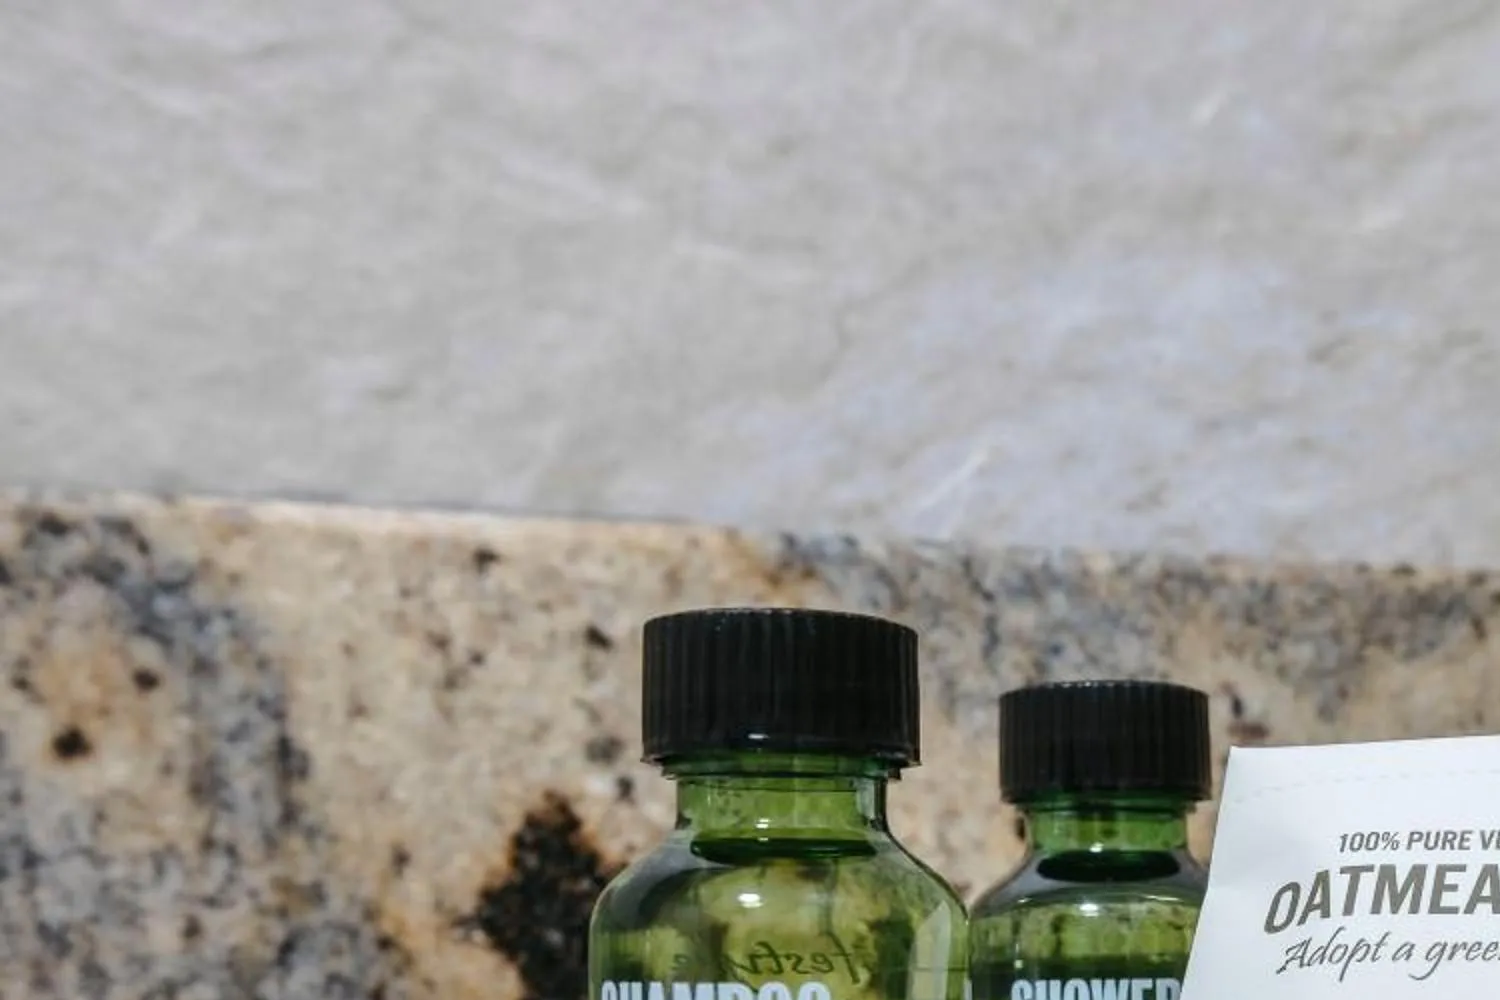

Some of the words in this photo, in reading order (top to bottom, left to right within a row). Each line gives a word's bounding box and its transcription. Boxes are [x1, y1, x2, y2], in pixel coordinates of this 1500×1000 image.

[1338, 830, 1400, 853] 100%
[1406, 829, 1472, 851] PURE
[1276, 926, 1391, 982] Adopt
[1391, 942, 1415, 962] a
